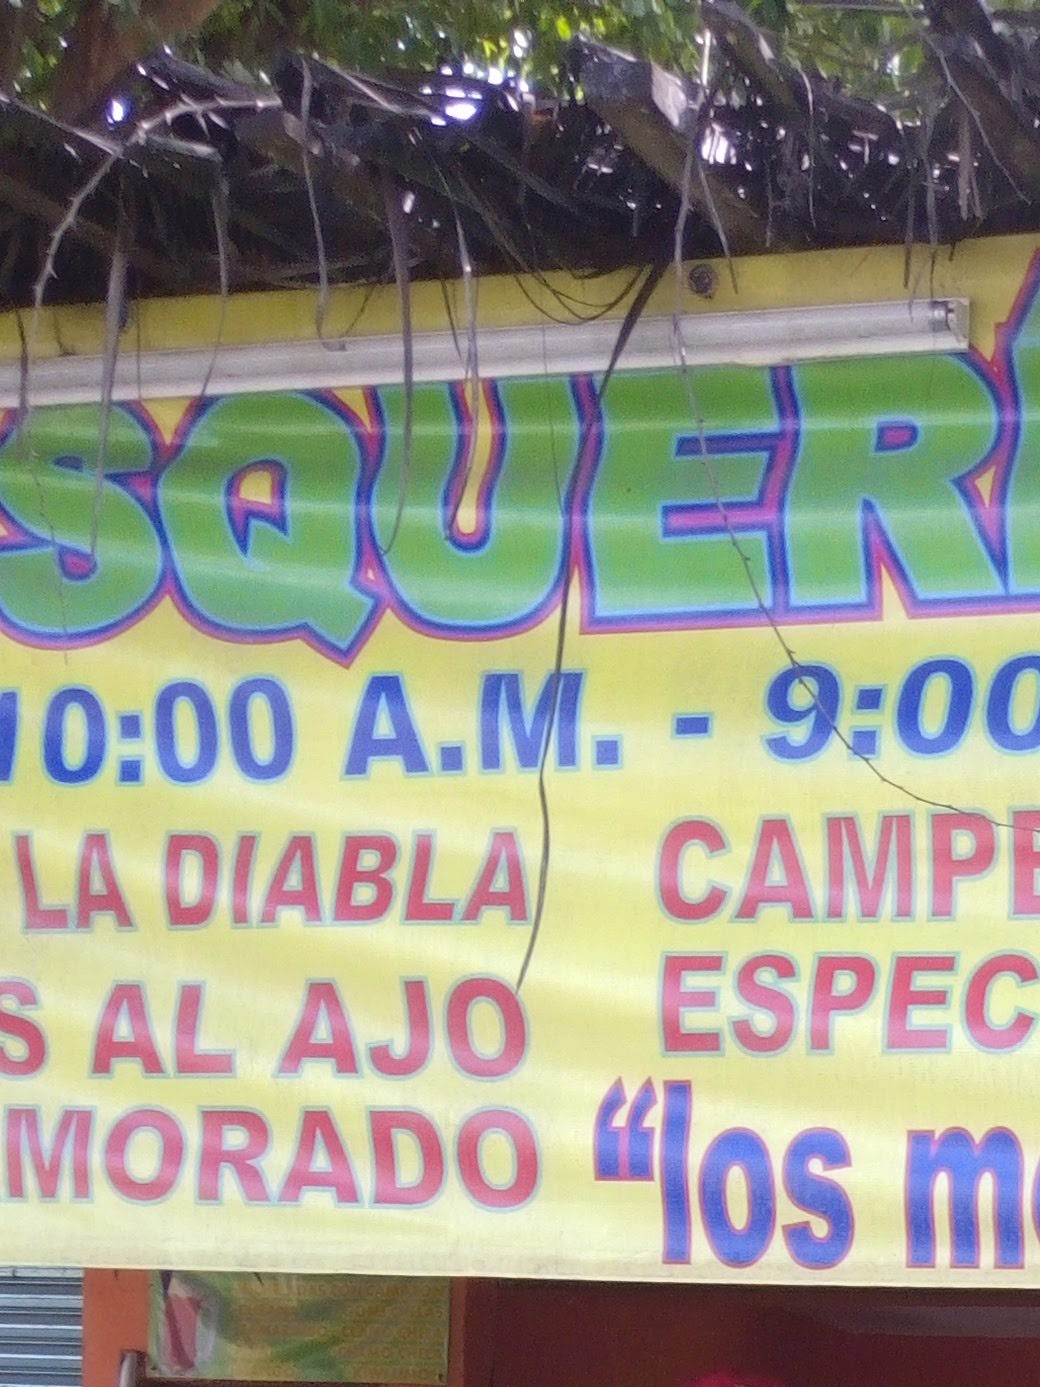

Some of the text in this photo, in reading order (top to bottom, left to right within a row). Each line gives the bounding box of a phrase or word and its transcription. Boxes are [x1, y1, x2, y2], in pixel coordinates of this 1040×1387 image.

[341, 670, 624, 781] A.M.
[673, 712, 712, 737] -
[12, 827, 533, 934] LA DIABLA
[88, 979, 237, 1078] AL
[272, 972, 530, 1082] AJO
[4, 1103, 541, 1212] MORADO
